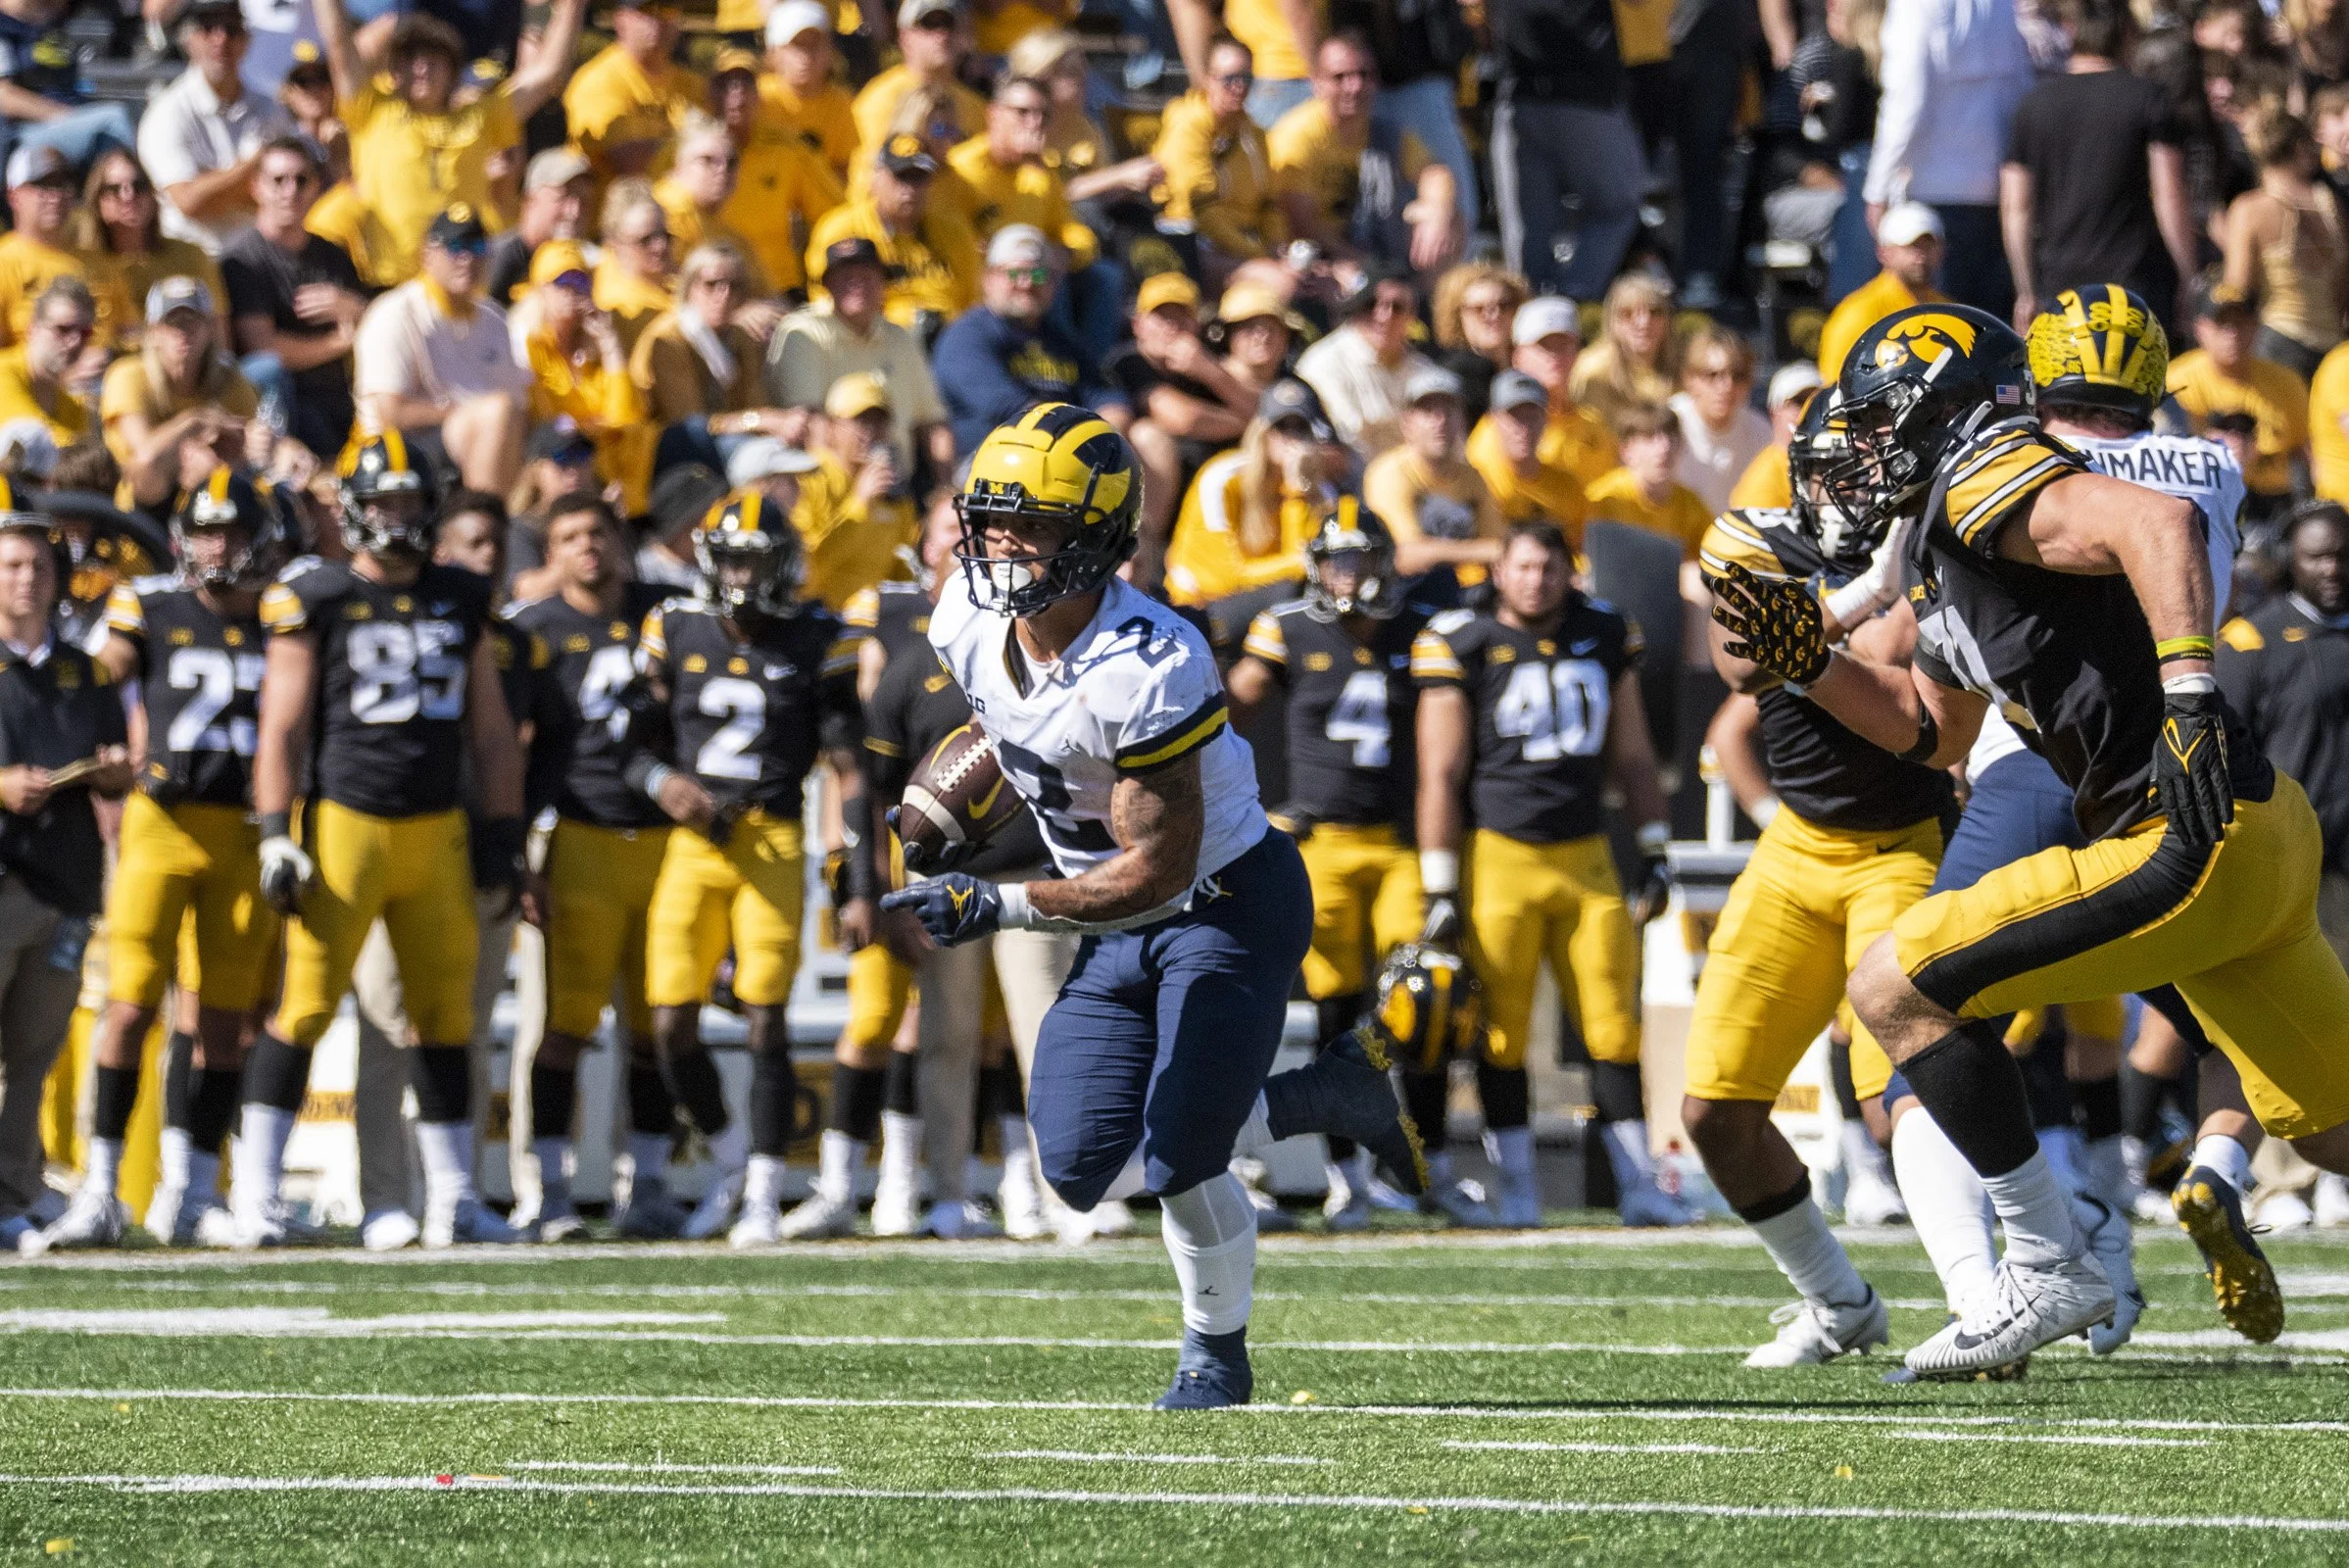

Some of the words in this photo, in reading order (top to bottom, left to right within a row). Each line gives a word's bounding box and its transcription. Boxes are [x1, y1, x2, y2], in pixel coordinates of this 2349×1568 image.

[347, 619, 467, 723] 85
[1326, 670, 1391, 767] 4
[1493, 660, 1611, 761] 40
[697, 676, 767, 780] 2
[998, 738, 1119, 852] 2
